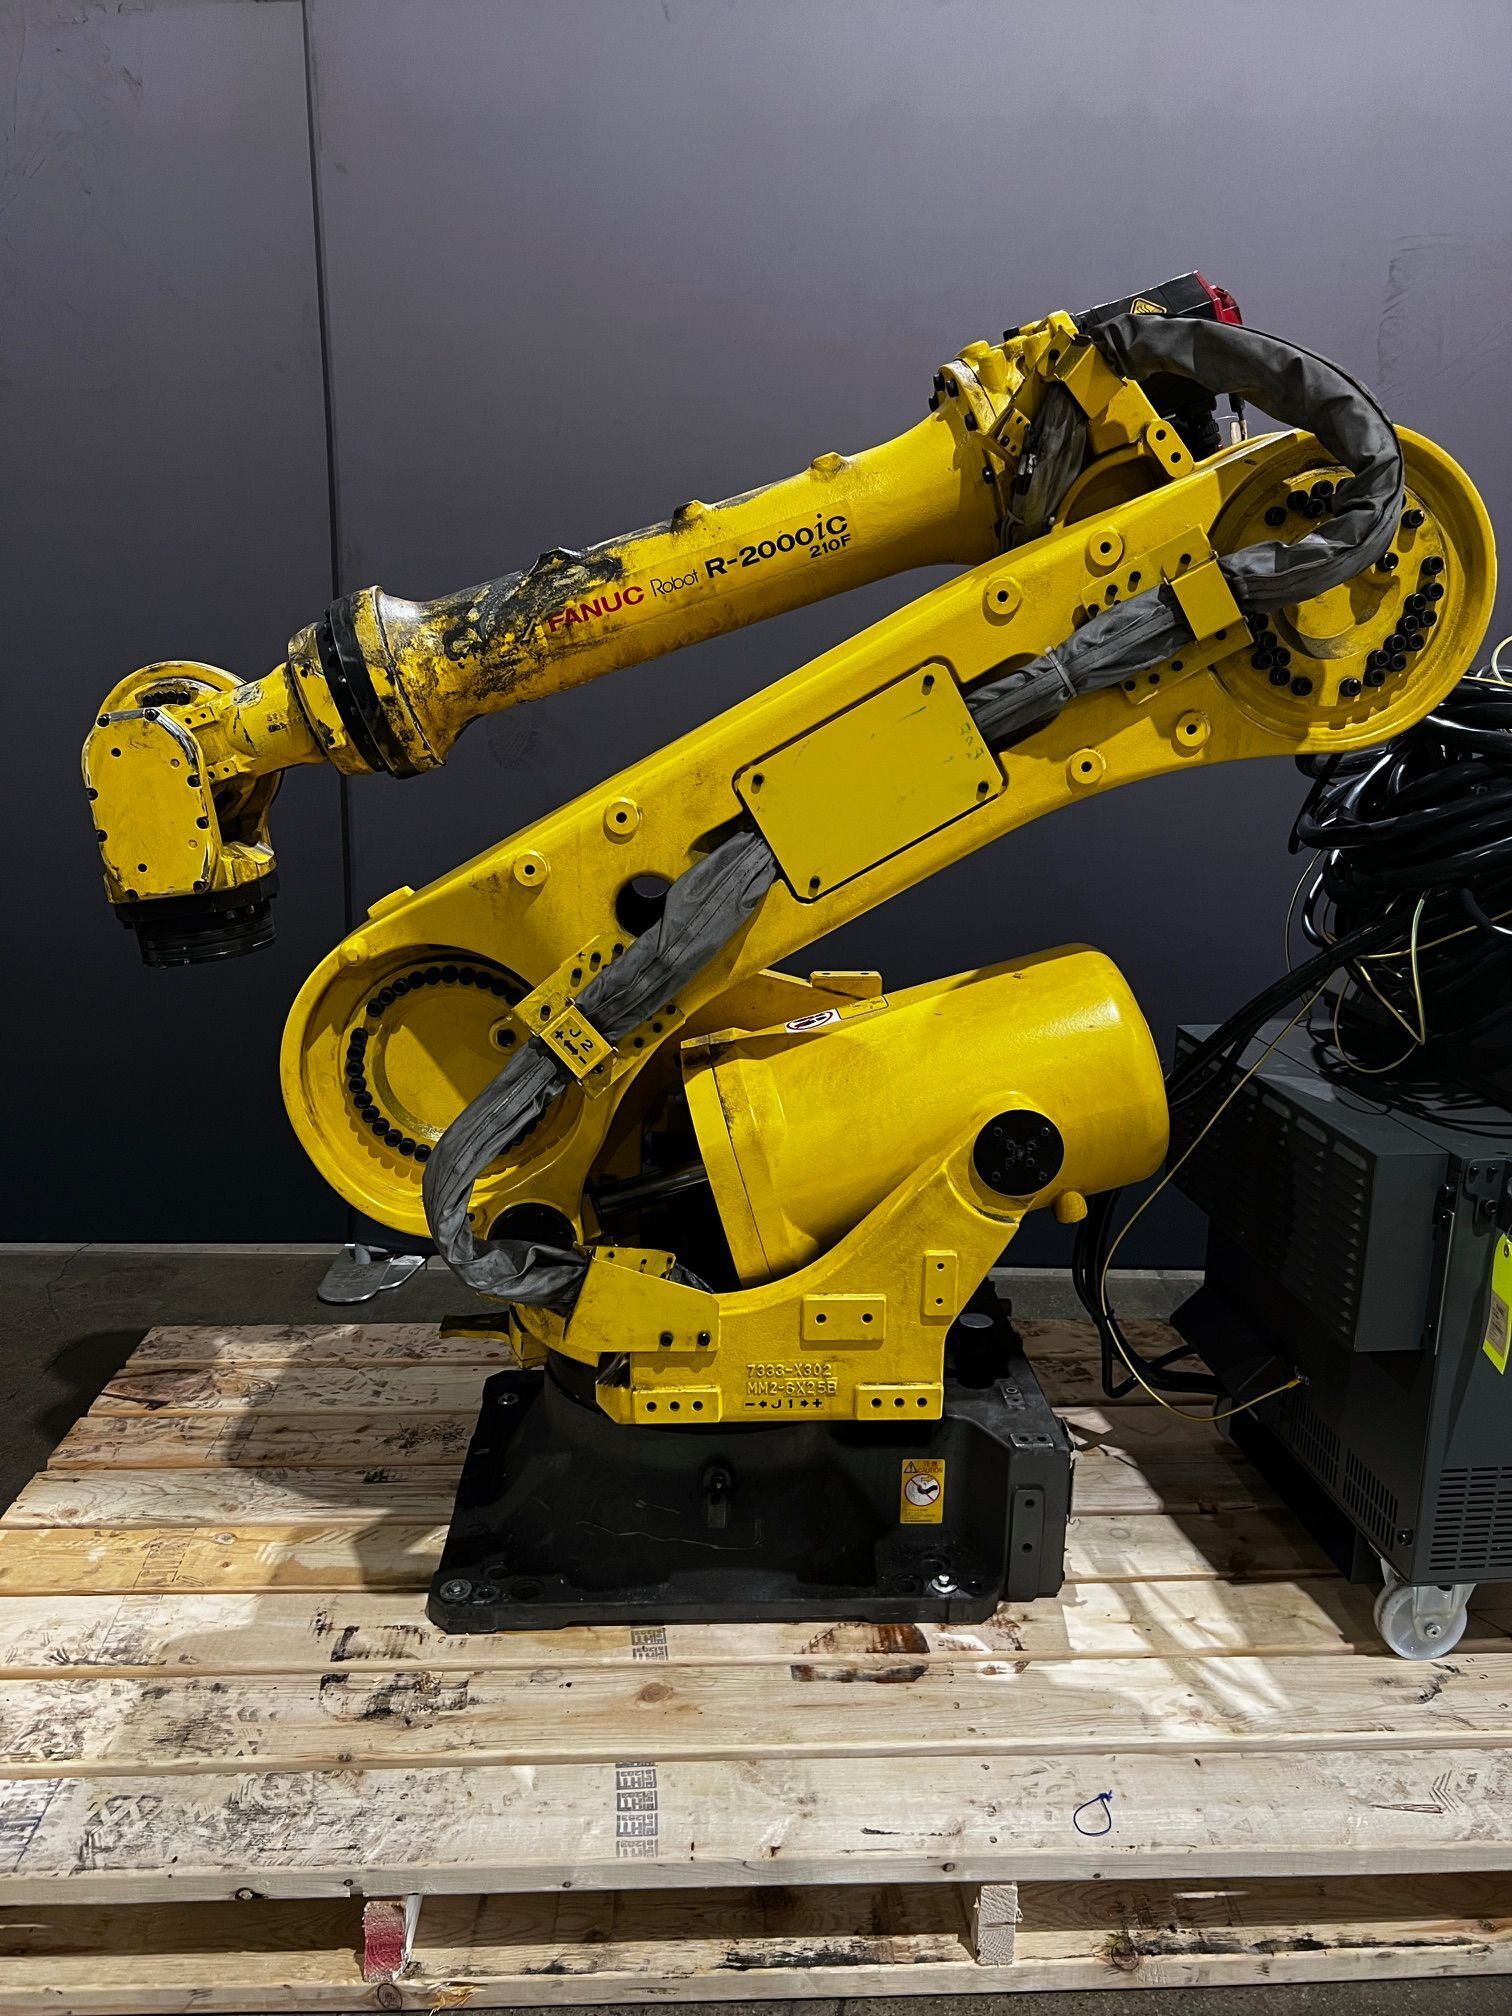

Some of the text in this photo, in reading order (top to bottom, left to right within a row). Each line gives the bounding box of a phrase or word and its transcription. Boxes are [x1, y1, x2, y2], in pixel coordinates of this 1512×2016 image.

[809, 533, 851, 559] 210F
[549, 512, 849, 632] FANUC Robot R-2000iC
[746, 1363, 832, 1378] 7333-X302
